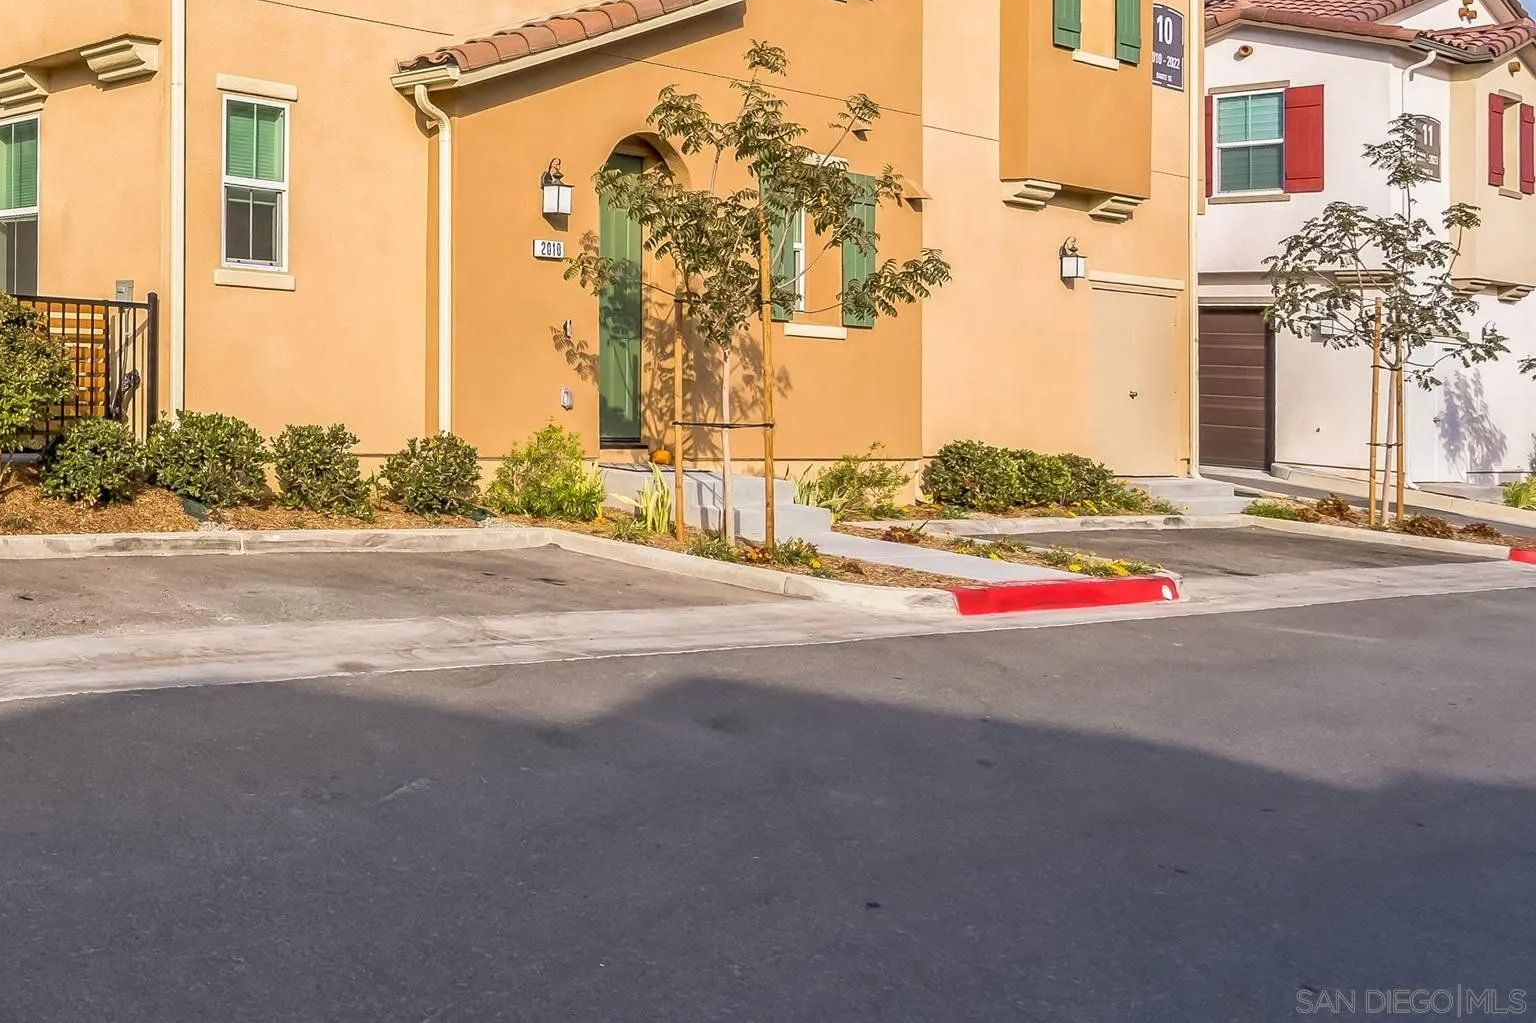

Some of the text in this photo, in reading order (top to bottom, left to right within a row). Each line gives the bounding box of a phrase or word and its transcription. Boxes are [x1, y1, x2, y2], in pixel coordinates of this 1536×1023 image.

[1157, 15, 1173, 45] 10
[1166, 55, 1181, 70] 2022
[1423, 124, 1433, 147] 11
[541, 241, 562, 257] 2010
